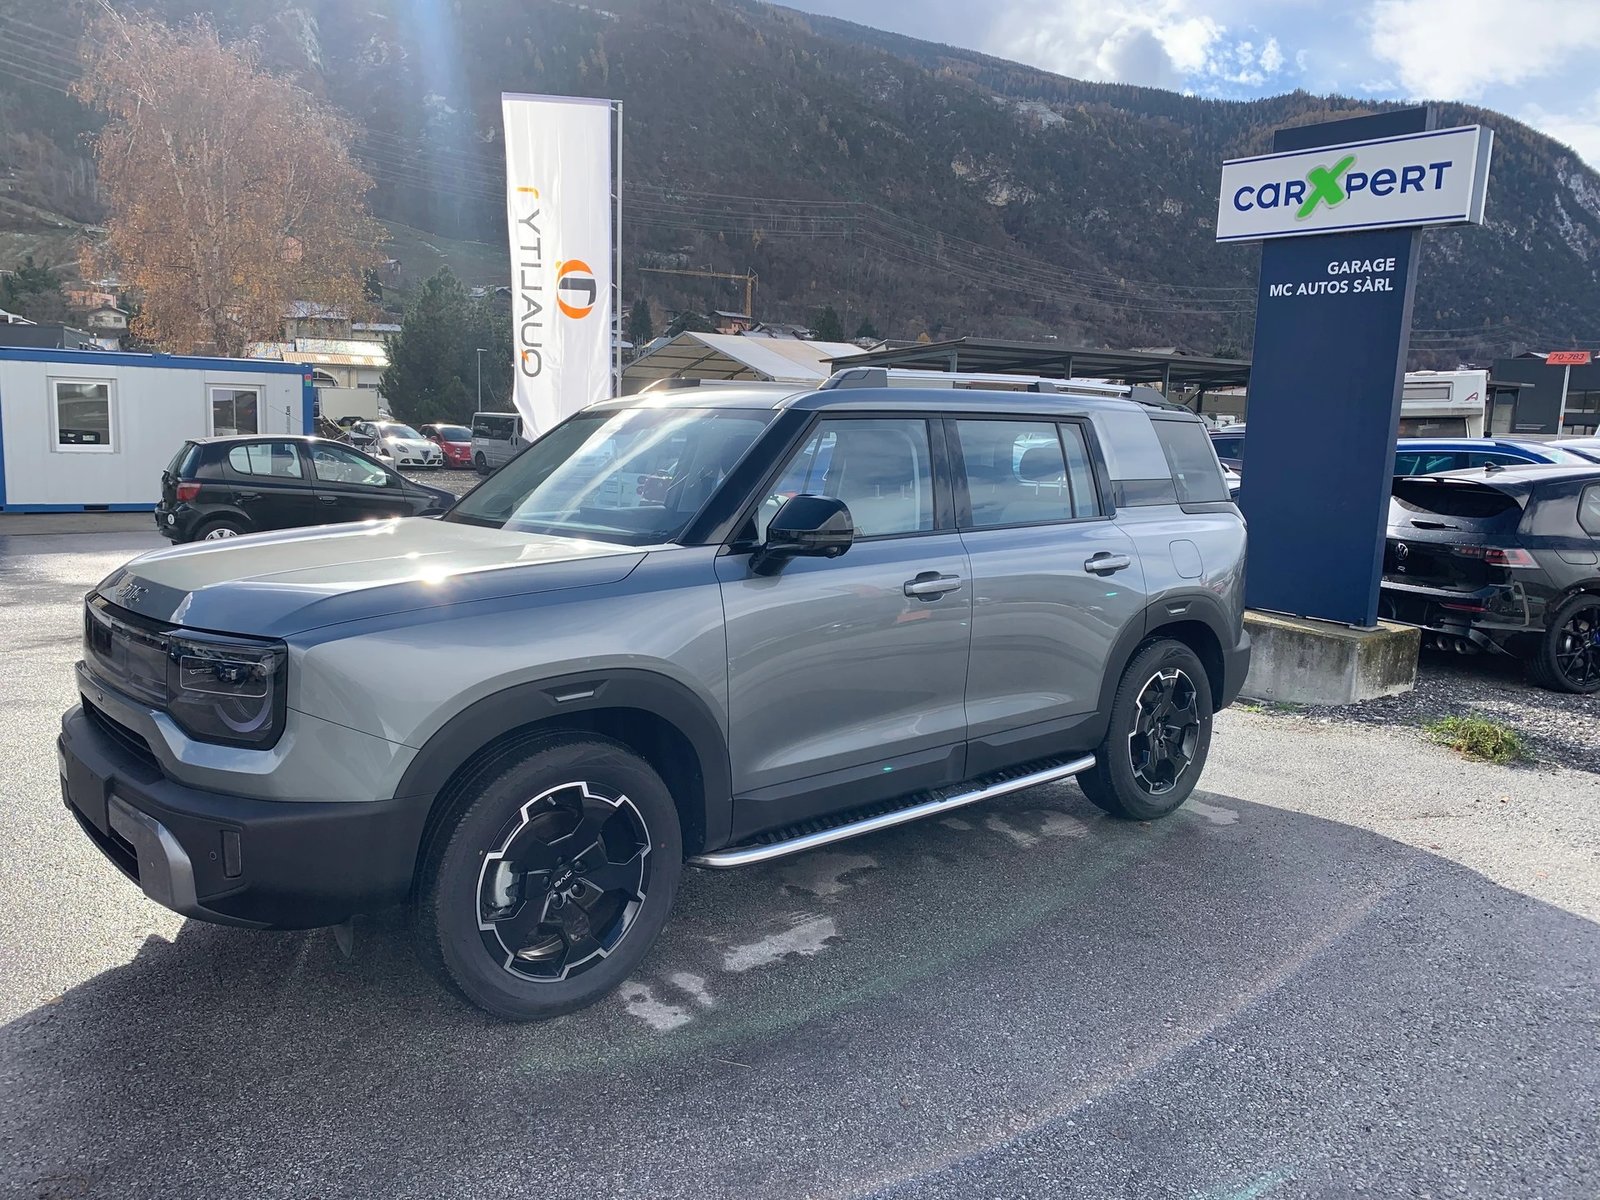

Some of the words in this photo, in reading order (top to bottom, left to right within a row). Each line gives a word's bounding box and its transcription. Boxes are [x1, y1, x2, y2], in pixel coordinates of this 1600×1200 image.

[1327, 257, 1396, 275] GARAGE
[1269, 282, 1293, 297] MC
[1296, 280, 1349, 296] AUTOS
[1352, 276, 1394, 293] SÀRL
